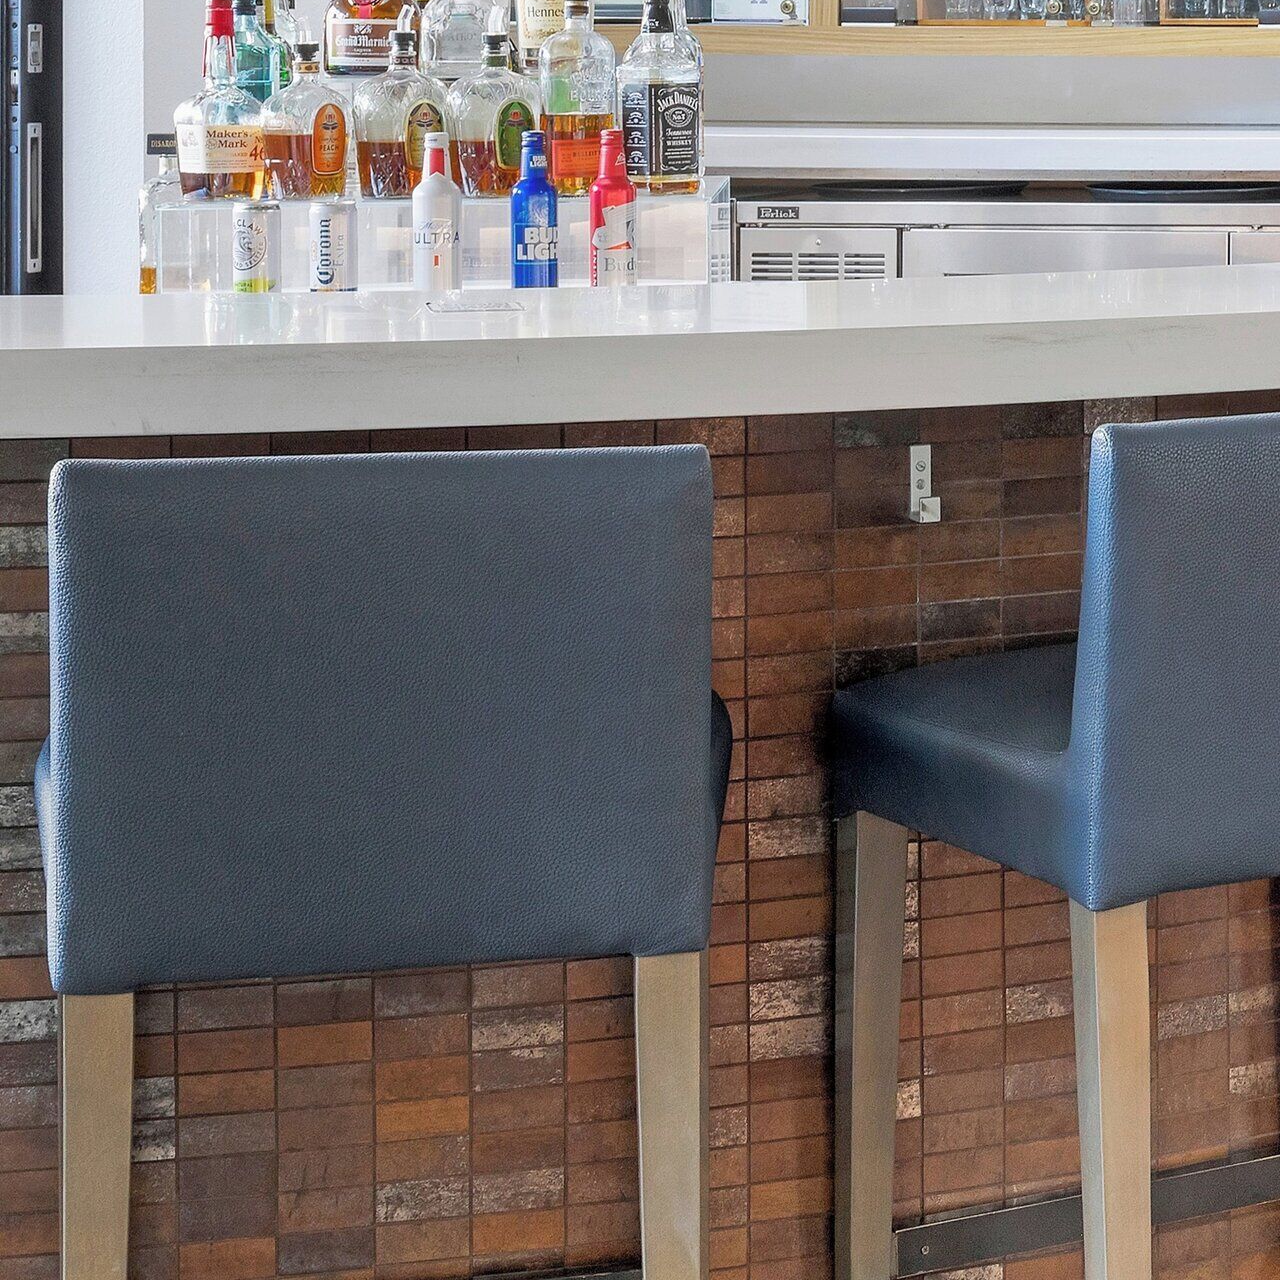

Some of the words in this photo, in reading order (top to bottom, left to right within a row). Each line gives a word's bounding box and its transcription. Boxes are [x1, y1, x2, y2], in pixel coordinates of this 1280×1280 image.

[527, 6, 565, 18] Hennes
[657, 95, 675, 112] JACK
[205, 130, 249, 139] Maker's
[217, 139, 248, 148] Mark
[760, 207, 797, 218] Perlick
[236, 219, 263, 236] CLAW
[414, 231, 460, 244] ULTRA
[316, 218, 334, 285] Corona
[516, 243, 558, 260] LIGH
